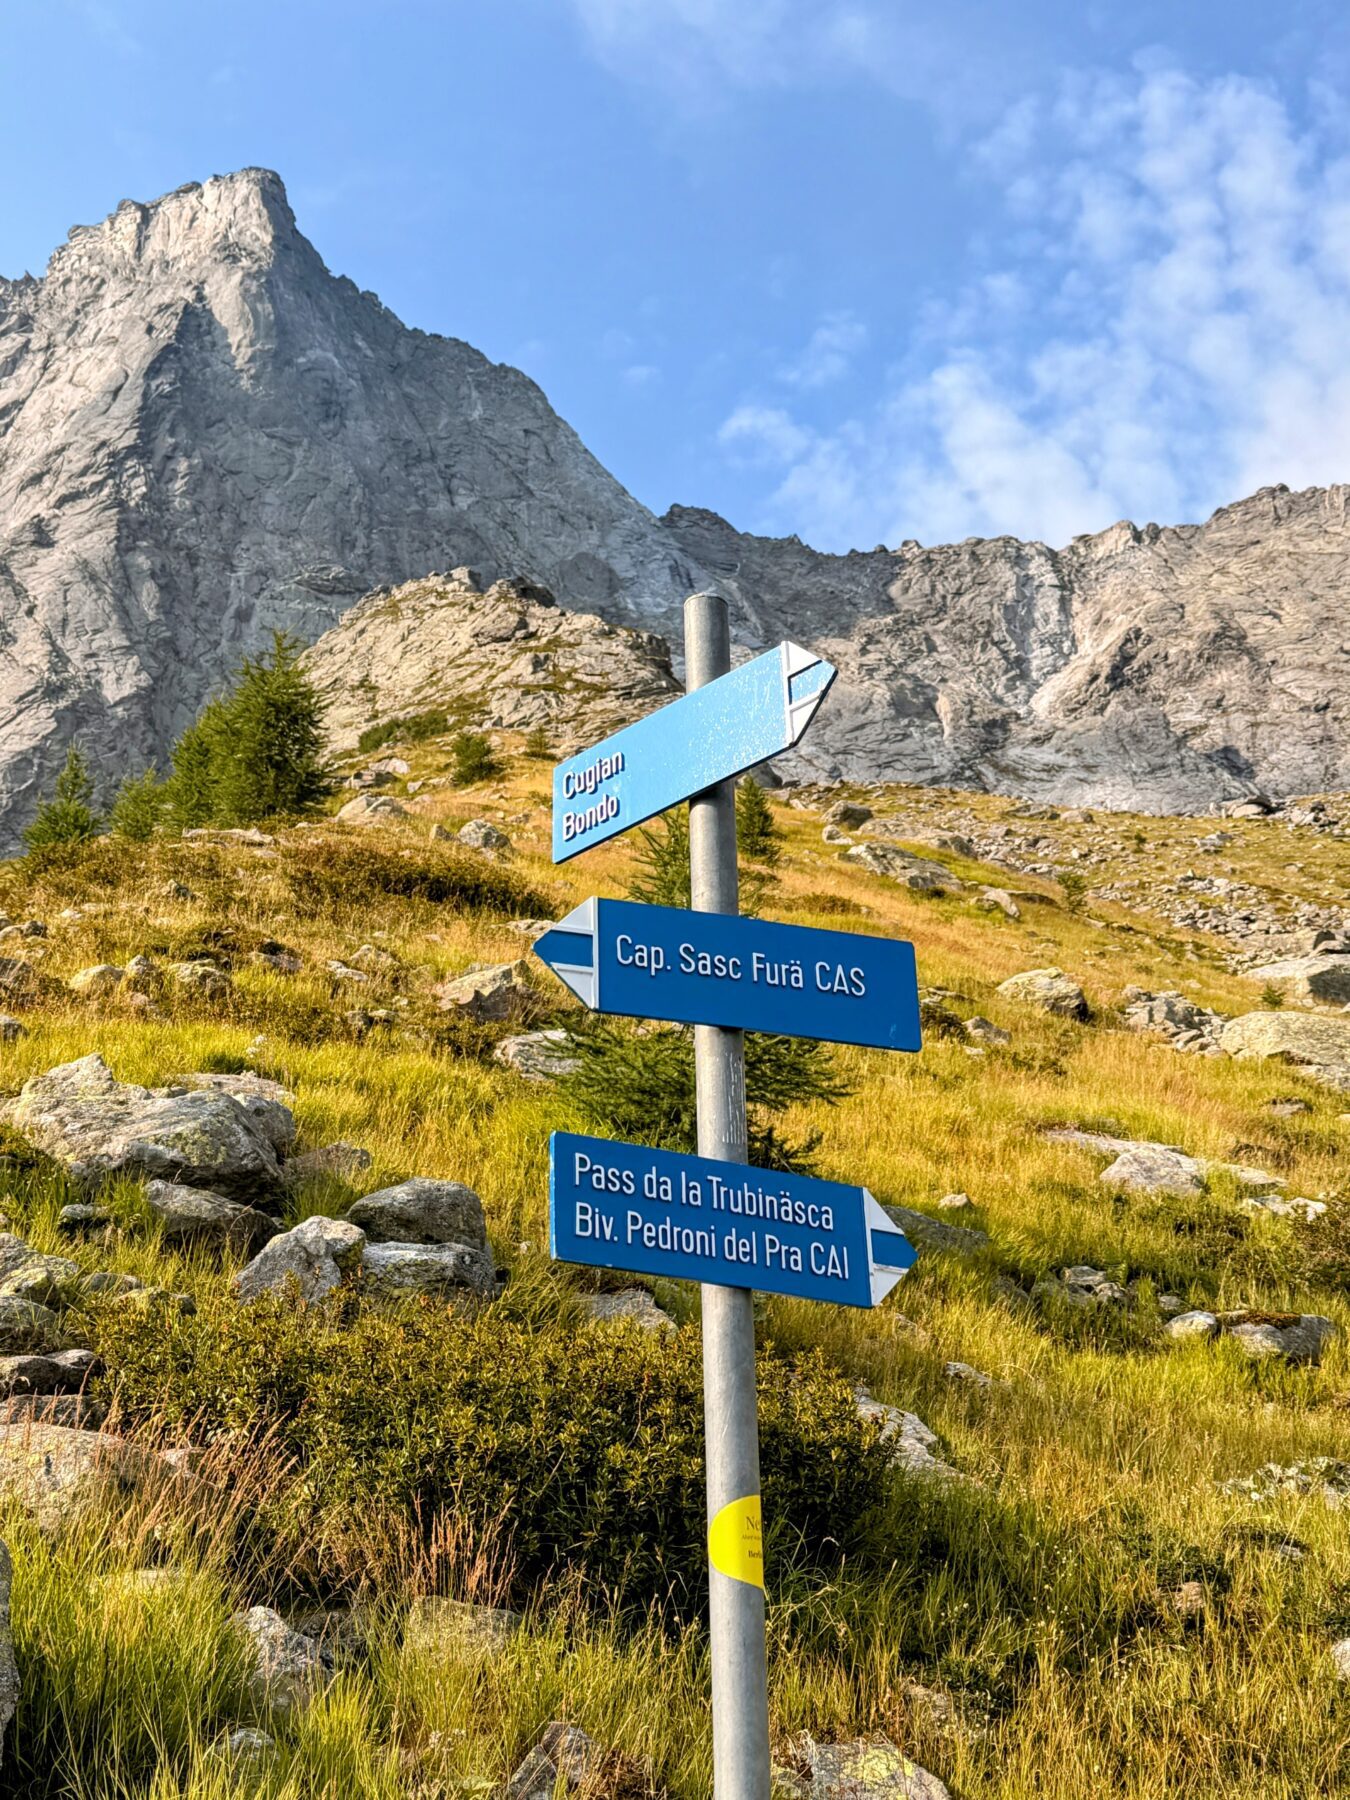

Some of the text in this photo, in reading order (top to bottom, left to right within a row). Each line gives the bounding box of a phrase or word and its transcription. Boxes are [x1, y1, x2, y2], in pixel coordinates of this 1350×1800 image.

[563, 751, 624, 798] Cugian
[563, 794, 619, 841] Bondo
[616, 934, 866, 997] Cap. Sasc Furä CAS
[574, 1152, 834, 1231] Pass da la Trubinäsca
[575, 1202, 849, 1280] Biv. Pedroni del Pra CAI
